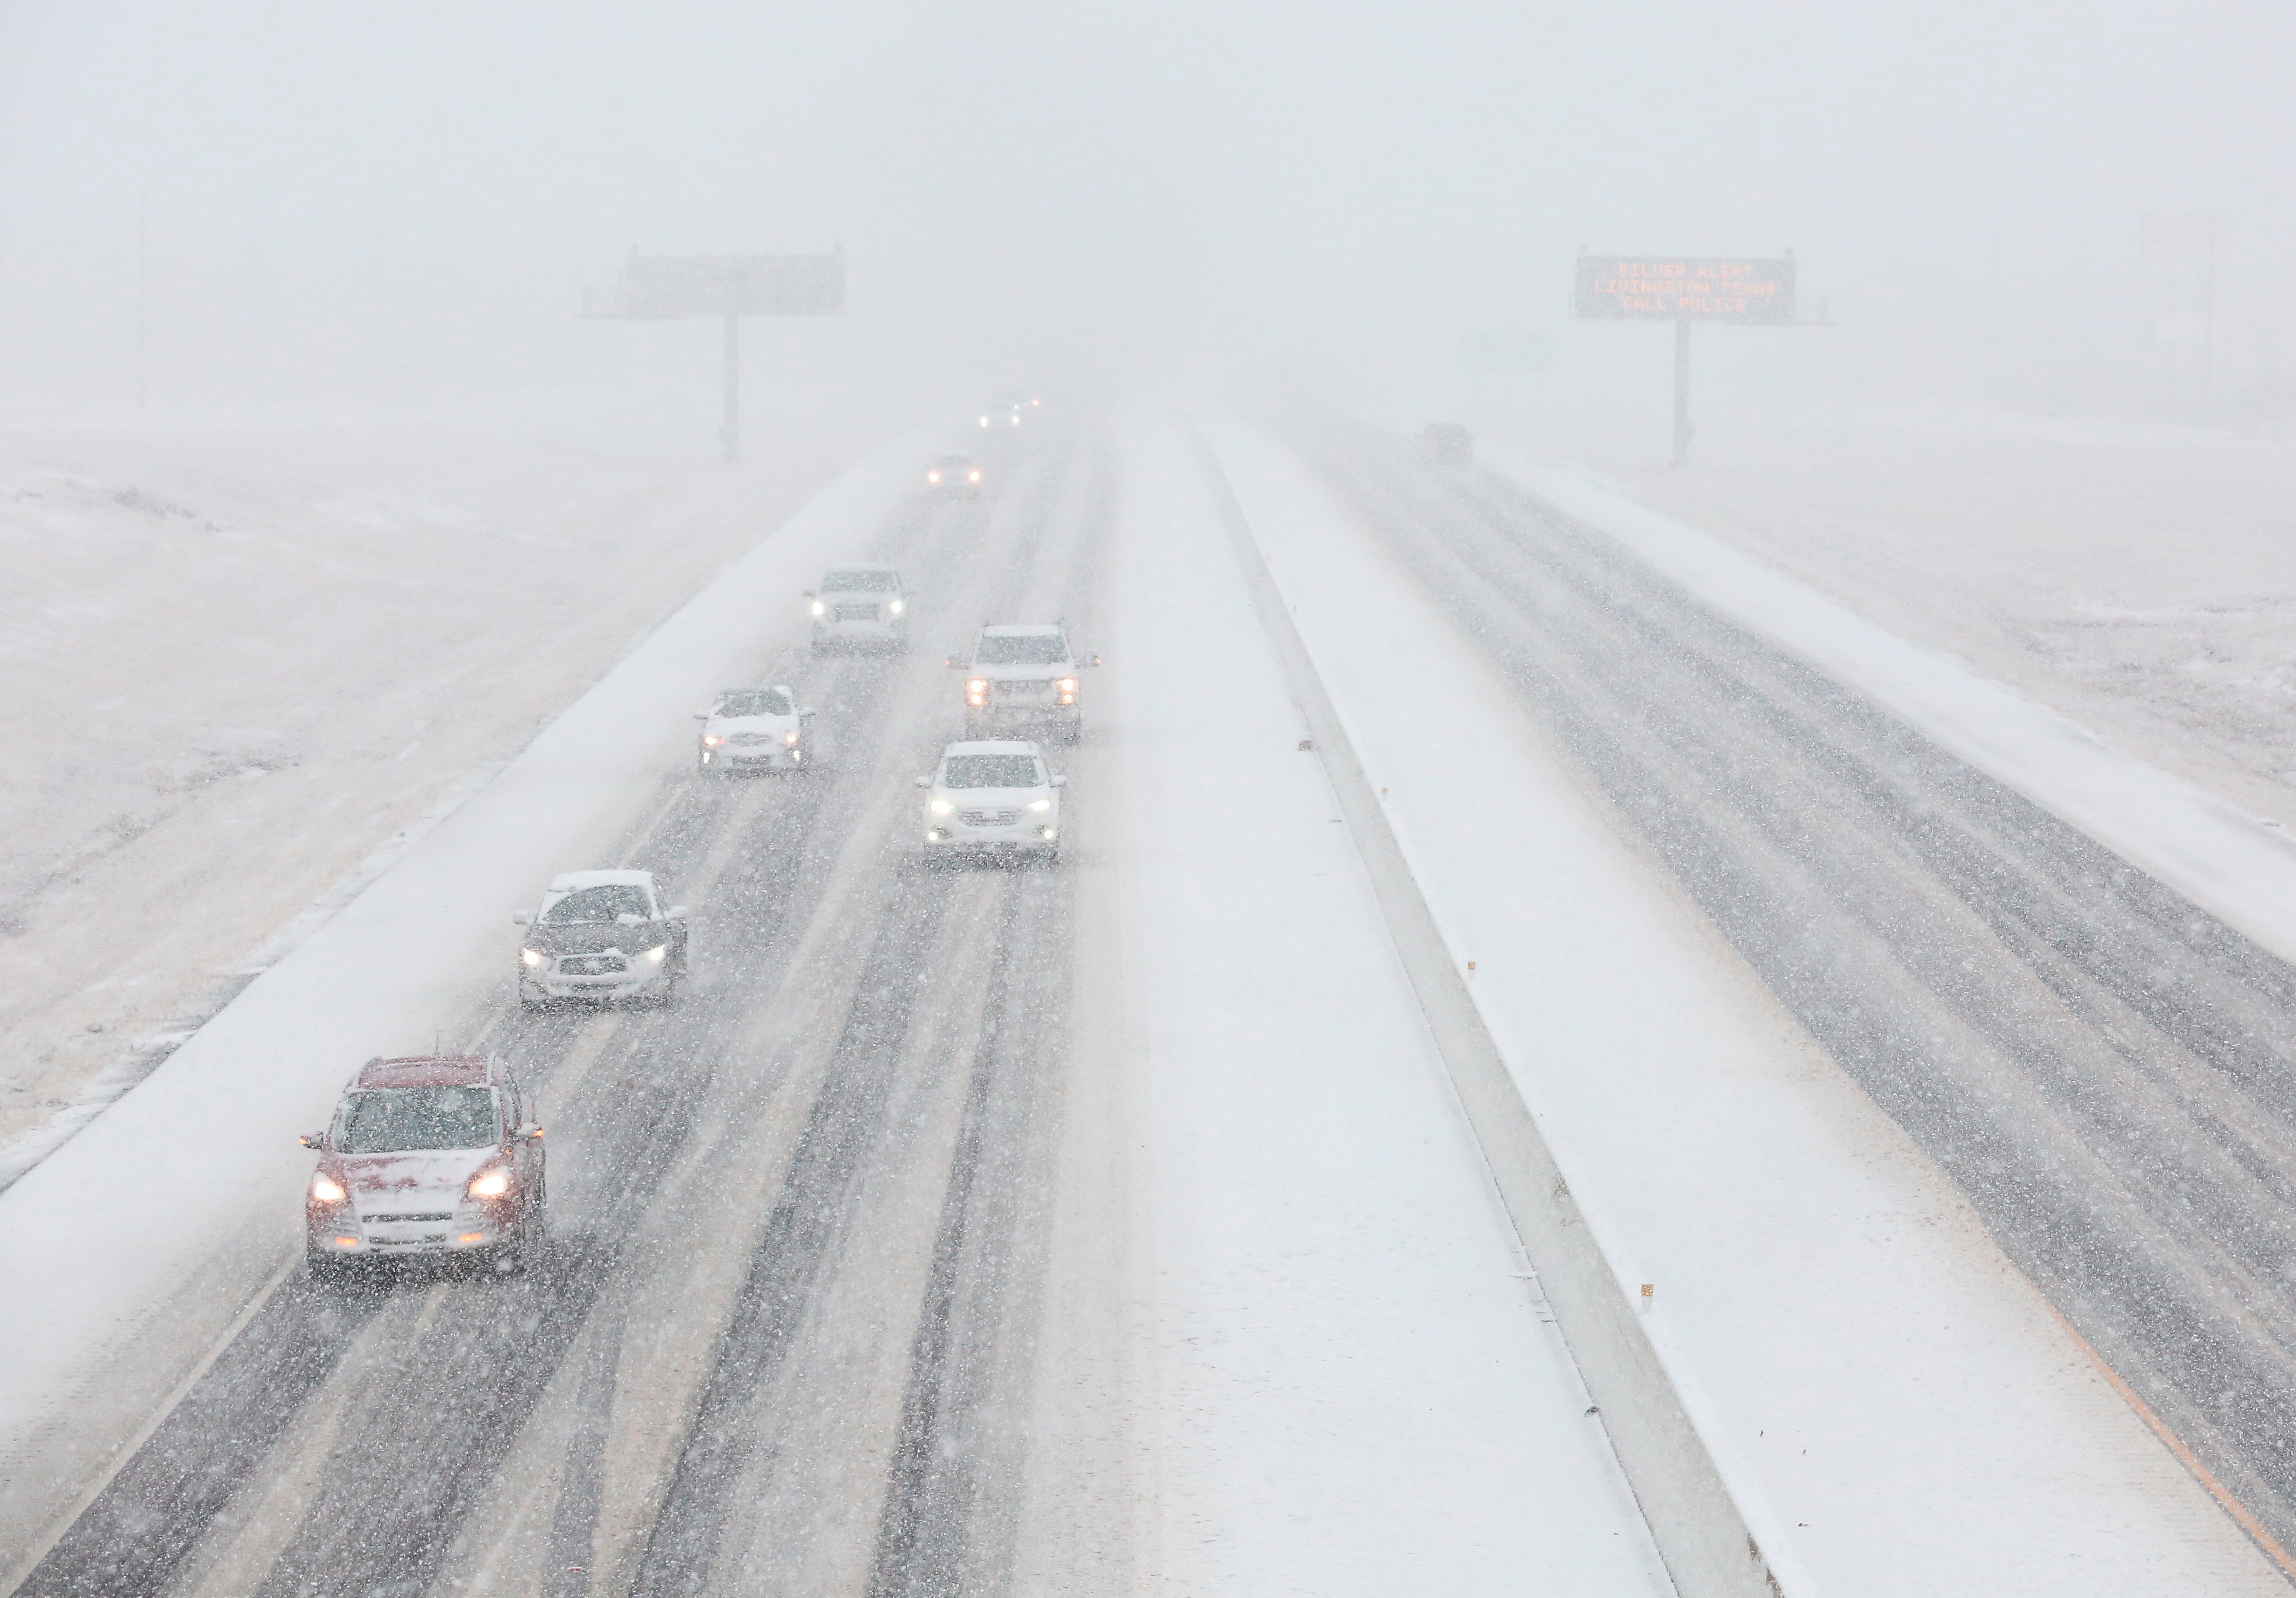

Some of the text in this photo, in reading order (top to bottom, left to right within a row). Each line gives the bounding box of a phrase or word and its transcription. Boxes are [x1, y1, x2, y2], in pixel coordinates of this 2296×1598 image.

[1618, 263, 1753, 279] SILVER ALERT
[1595, 280, 1710, 295] LIVINGSTON
[1622, 296, 1746, 312] CALL POLICE
